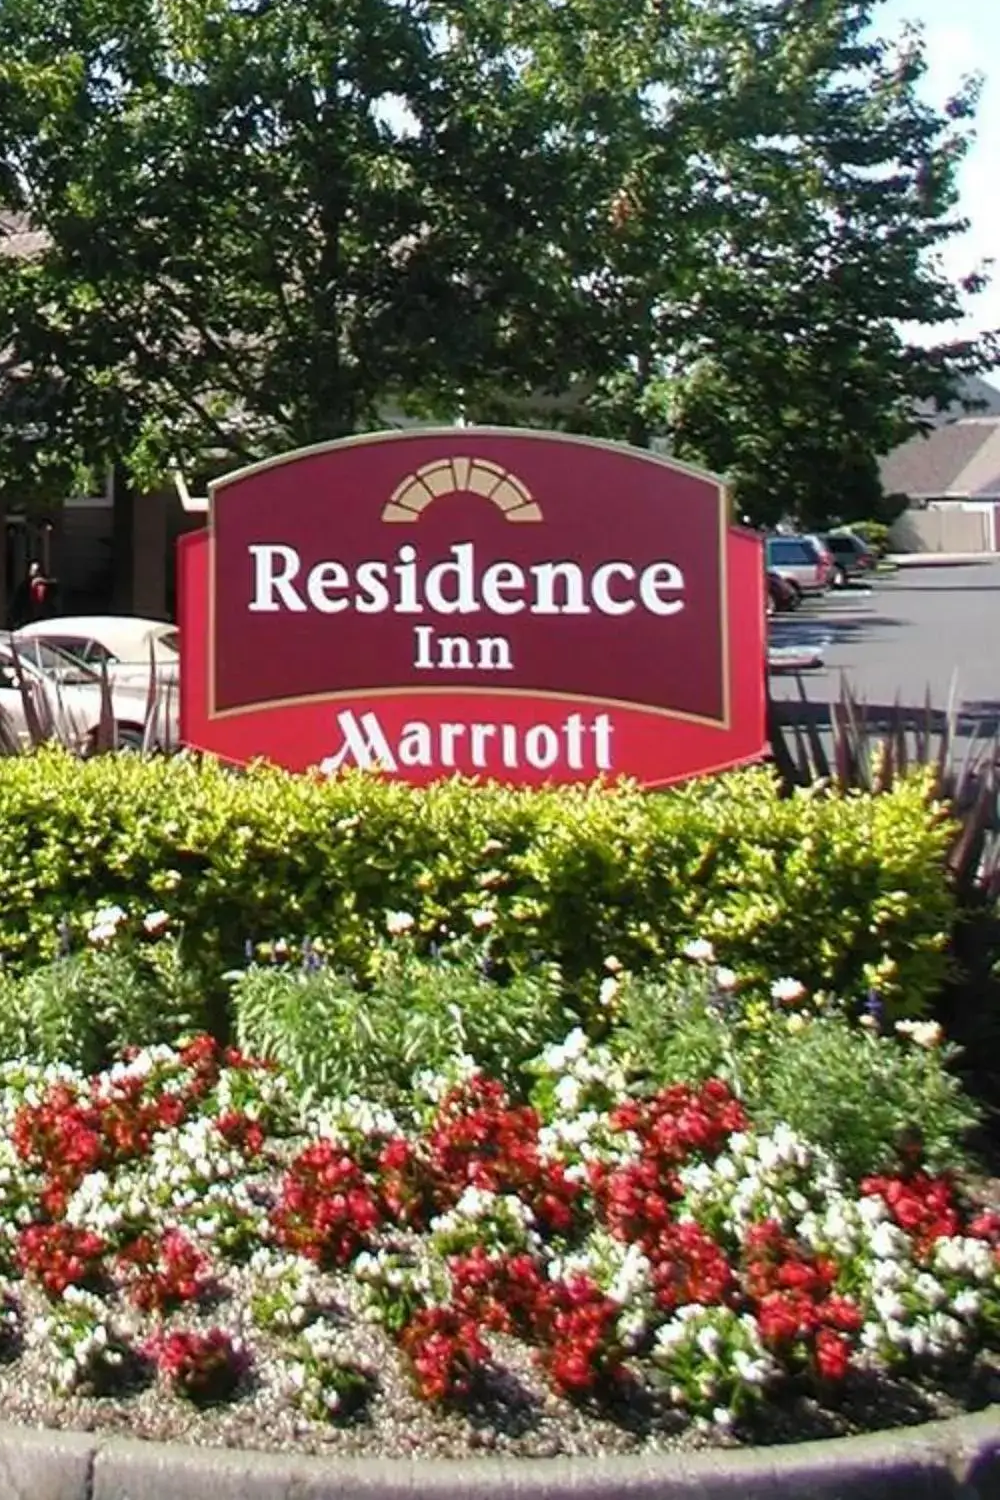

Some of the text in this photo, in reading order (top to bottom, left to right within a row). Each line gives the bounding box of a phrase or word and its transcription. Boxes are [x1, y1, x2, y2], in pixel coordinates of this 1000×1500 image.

[247, 542, 686, 616] Residence
[413, 626, 514, 670] Inn
[320, 708, 615, 773] Marriott
